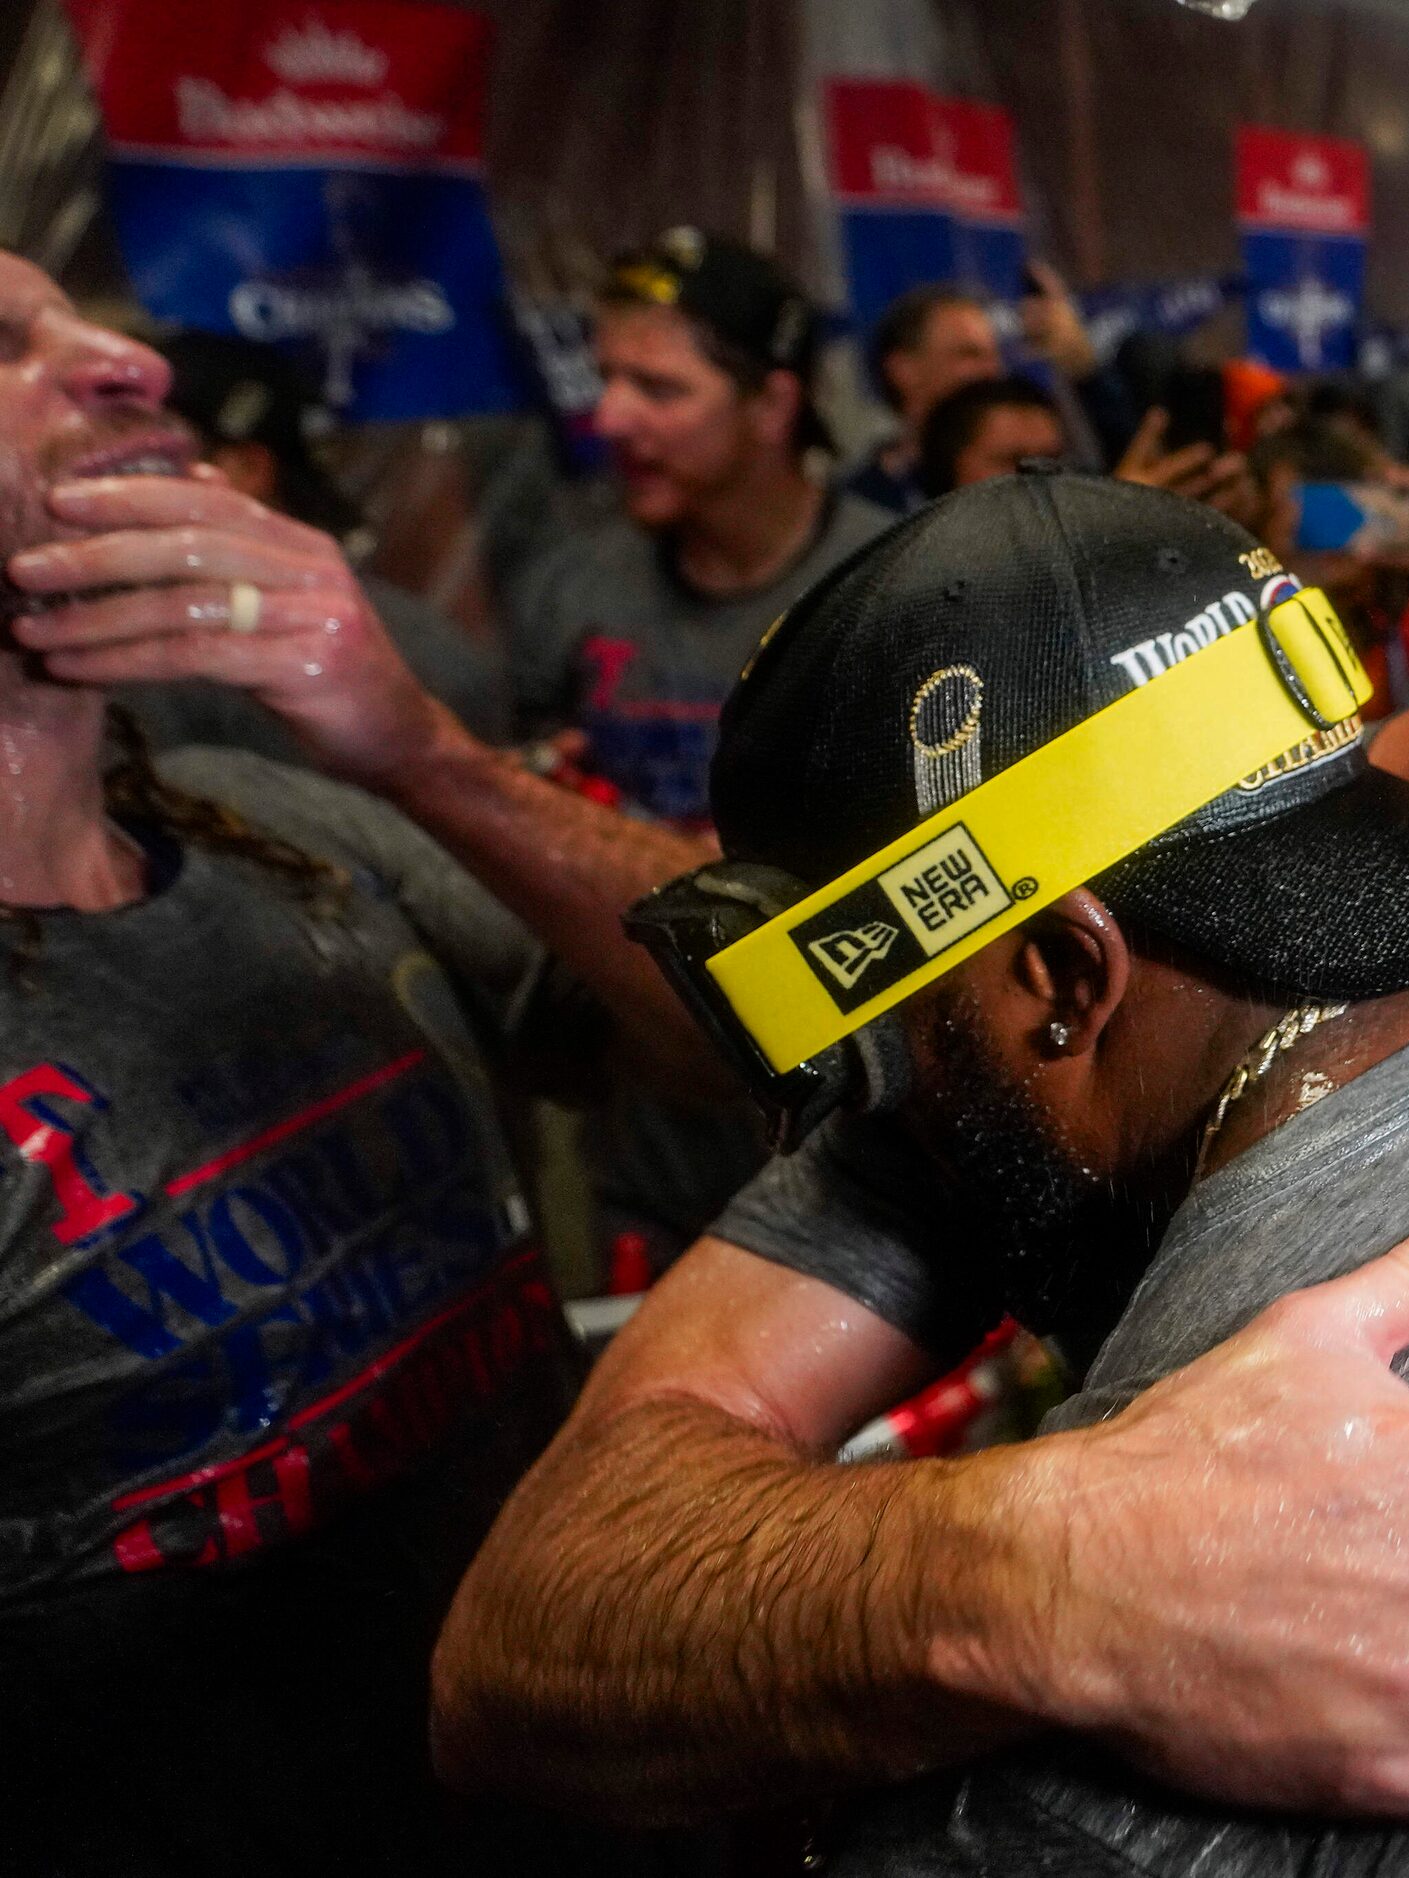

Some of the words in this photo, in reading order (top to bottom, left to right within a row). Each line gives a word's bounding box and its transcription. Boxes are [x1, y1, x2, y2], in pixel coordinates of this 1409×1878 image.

[899, 848, 972, 908] NEW
[917, 872, 990, 932] ERA
[64, 1078, 468, 1360] WORLD
